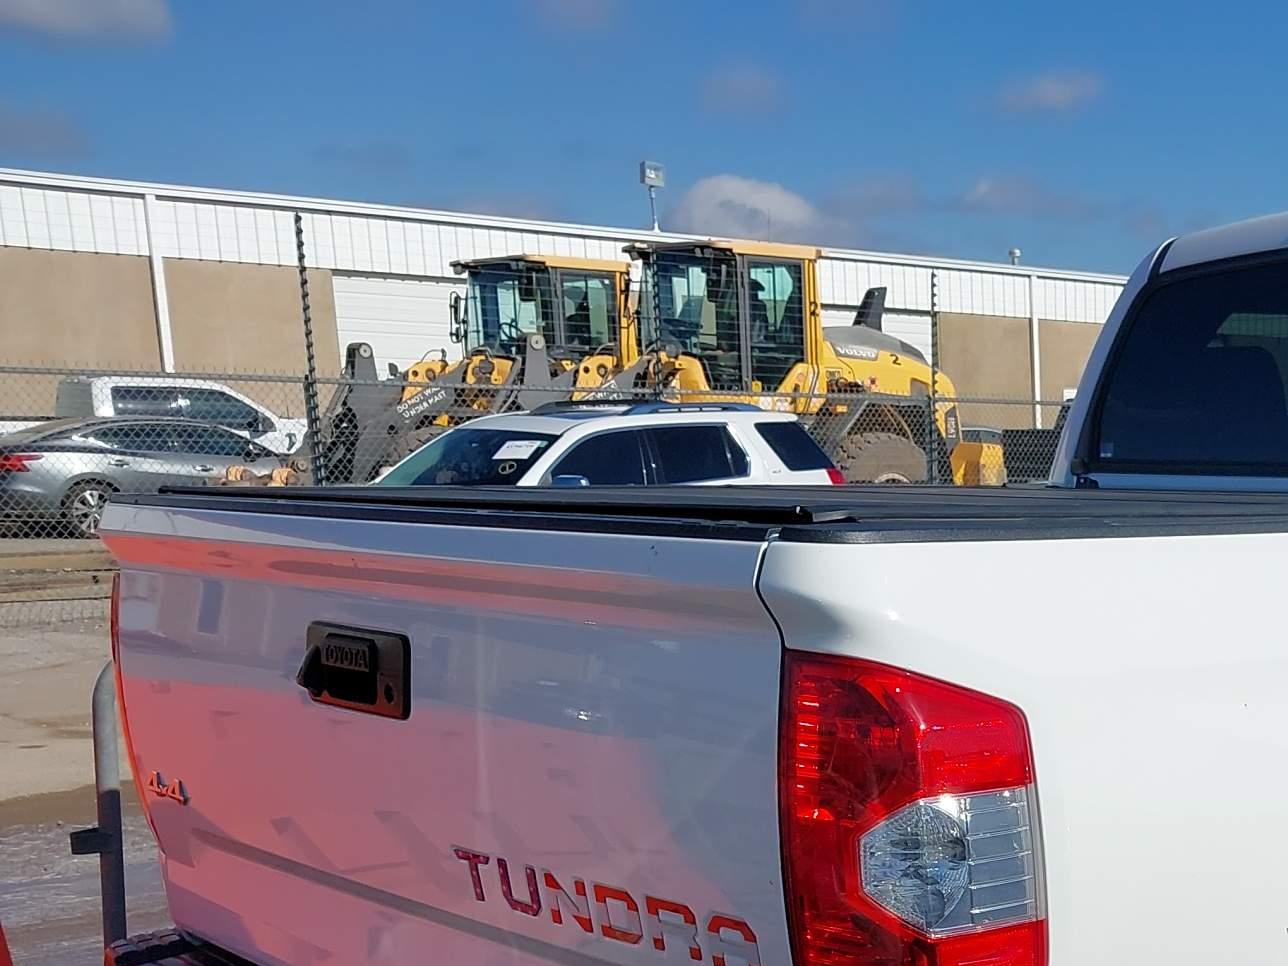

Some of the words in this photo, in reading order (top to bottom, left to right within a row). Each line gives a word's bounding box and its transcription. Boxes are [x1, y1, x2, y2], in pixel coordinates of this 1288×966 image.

[836, 346, 876, 358] VOLVO
[889, 353, 902, 366] 2
[322, 643, 369, 669] TOYOTA
